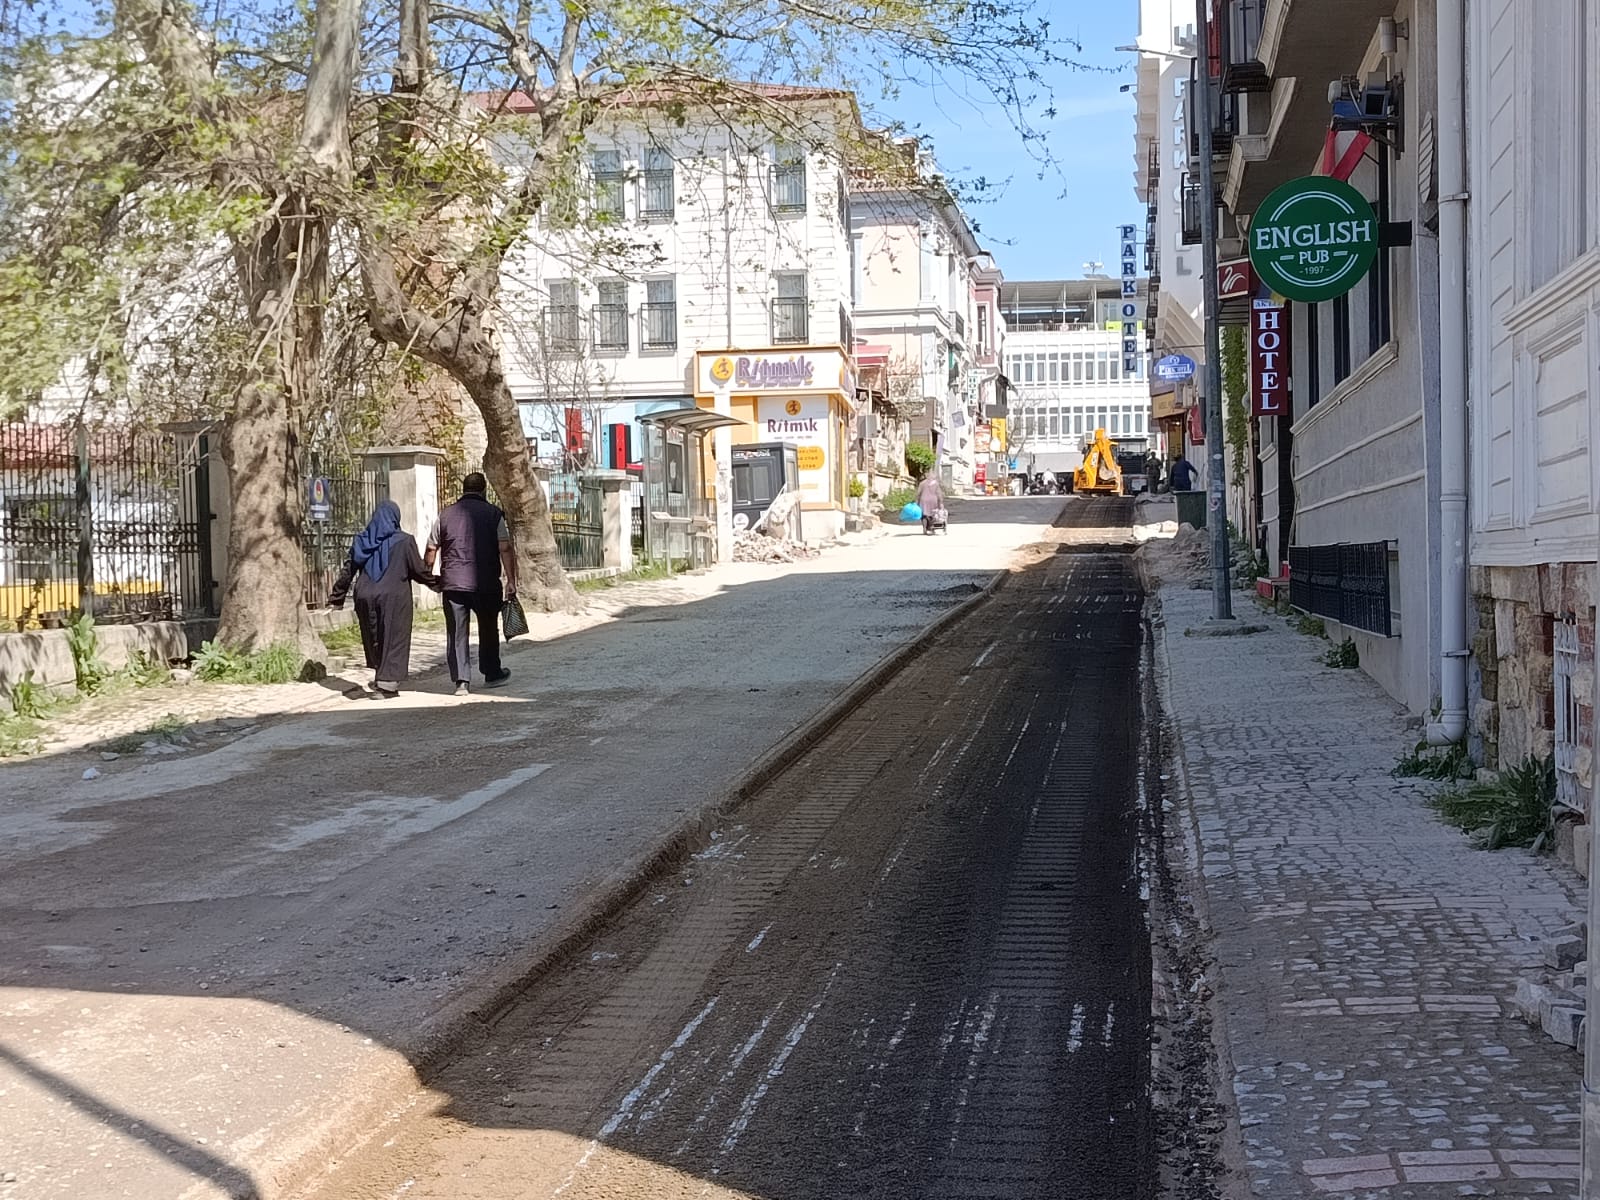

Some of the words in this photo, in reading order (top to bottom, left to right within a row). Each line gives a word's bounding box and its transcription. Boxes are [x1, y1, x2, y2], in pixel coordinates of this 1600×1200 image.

[1255, 219, 1372, 250] ENGLISH
[1122, 226, 1136, 293] PARK
[1299, 250, 1330, 265] PUB
[1122, 304, 1136, 371] OTEL
[737, 355, 815, 378] Ritmik
[1257, 311, 1280, 410] HOTEL
[767, 417, 818, 433] Ritmik
